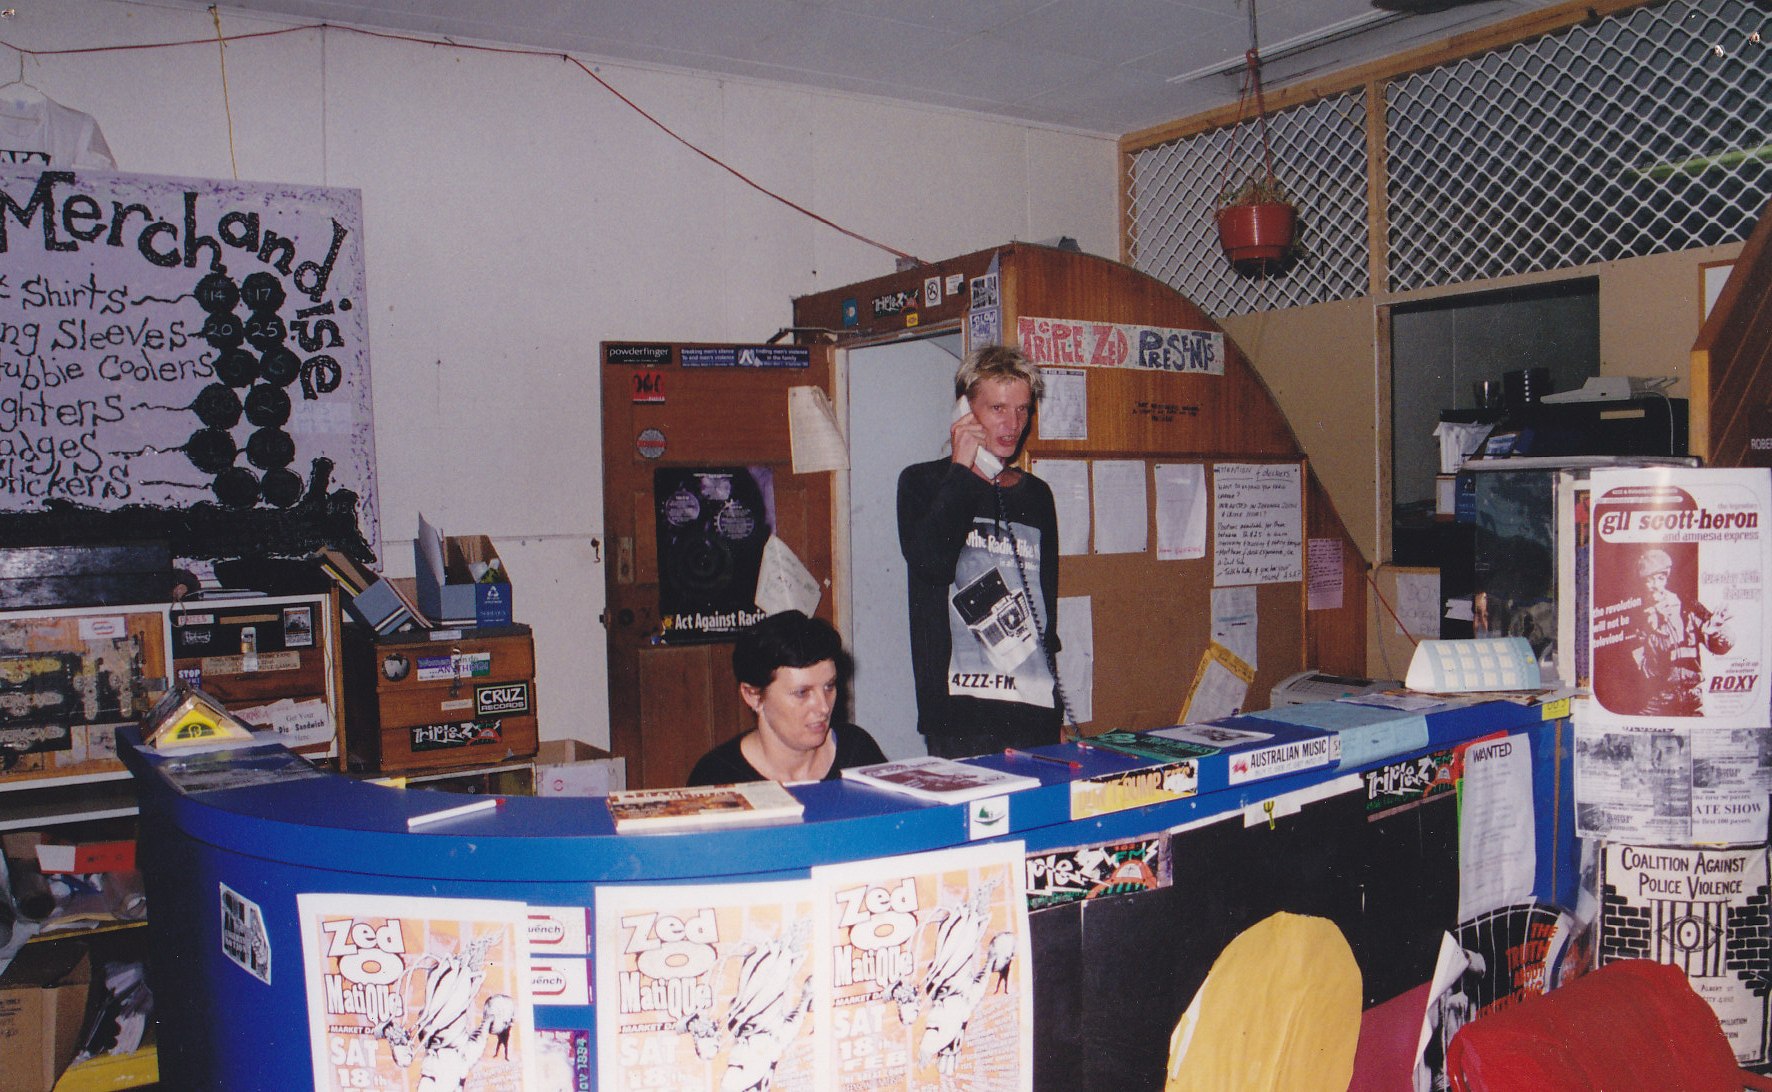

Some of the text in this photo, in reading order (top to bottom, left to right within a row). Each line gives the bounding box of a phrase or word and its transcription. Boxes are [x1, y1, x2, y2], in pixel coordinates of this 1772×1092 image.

[0, 171, 352, 400] Merchandise
[21, 273, 128, 315] Shirts
[52, 318, 188, 351] Sleeves
[208, 324, 233, 336] 20
[252, 323, 278, 336] 25
[609, 347, 669, 357] powderfinger
[99, 350, 214, 382] Coolers
[1602, 509, 1759, 535] gil scott-heron
[1724, 531, 1760, 543] express
[1606, 597, 1642, 615] revolution
[675, 613, 693, 631] Act
[694, 610, 736, 632] Against
[1607, 617, 1620, 629] not
[178, 669, 201, 679] STOP
[1710, 674, 1758, 691] ROXY
[480, 688, 524, 705] CRUZ
[481, 701, 525, 711] RECORDS
[412, 725, 461, 744] Triple
[1250, 746, 1300, 768] AUSTRALIAN
[1302, 739, 1328, 758] MUSIC
[1472, 742, 1513, 763] WANTED
[1366, 762, 1418, 800] Triple
[1724, 803, 1761, 815] SHOW
[1621, 847, 1745, 875] COALITION AGAINST
[1639, 872, 1743, 900] POLICE VIOLENCE
[835, 877, 919, 929] Zed
[323, 918, 406, 957] Zed
[621, 907, 720, 955] Zed
[330, 1025, 364, 1035] MARKET
[832, 1003, 887, 1039] SAT
[331, 1036, 379, 1068] SAT
[620, 1036, 681, 1066] SAT
